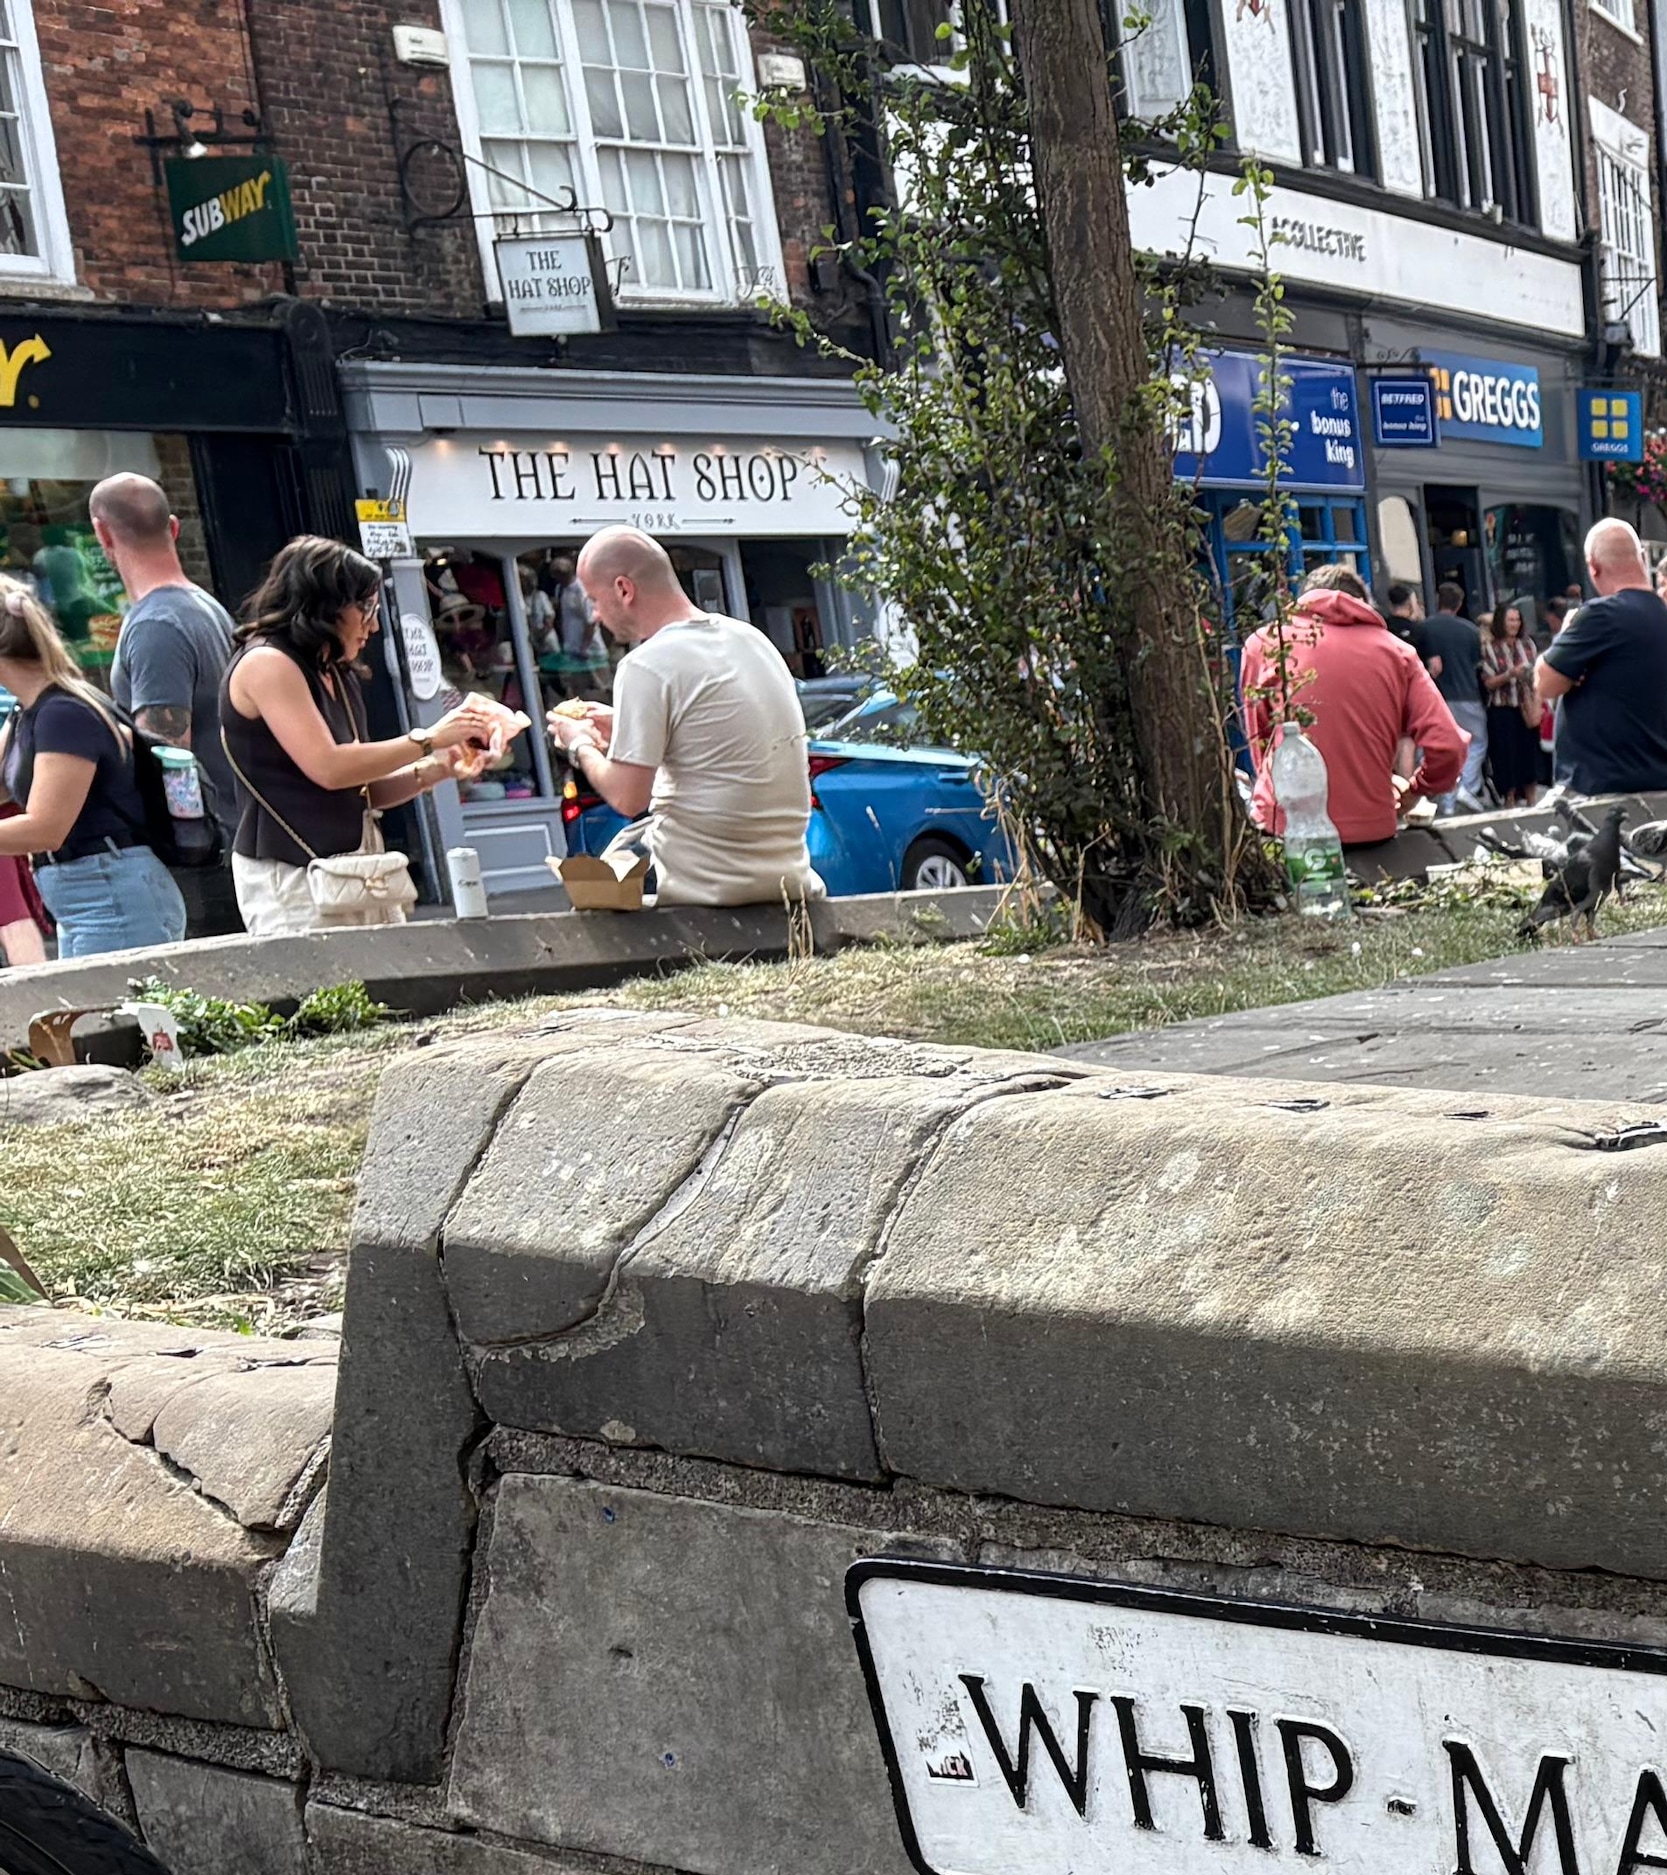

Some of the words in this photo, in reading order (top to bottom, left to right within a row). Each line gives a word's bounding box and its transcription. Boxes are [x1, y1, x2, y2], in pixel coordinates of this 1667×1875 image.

[181, 170, 272, 246] SUBWAY
[526, 250, 562, 271] THE
[508, 278, 543, 299] HAT
[546, 276, 591, 297] SHOP
[1331, 387, 1349, 411] the
[1453, 369, 1541, 430] GREGGS
[1310, 410, 1351, 437] bonus
[1325, 439, 1354, 469] king
[479, 446, 576, 500] THE
[591, 450, 676, 500] HAT
[692, 452, 798, 501] SHOP
[631, 513, 681, 530] YORK
